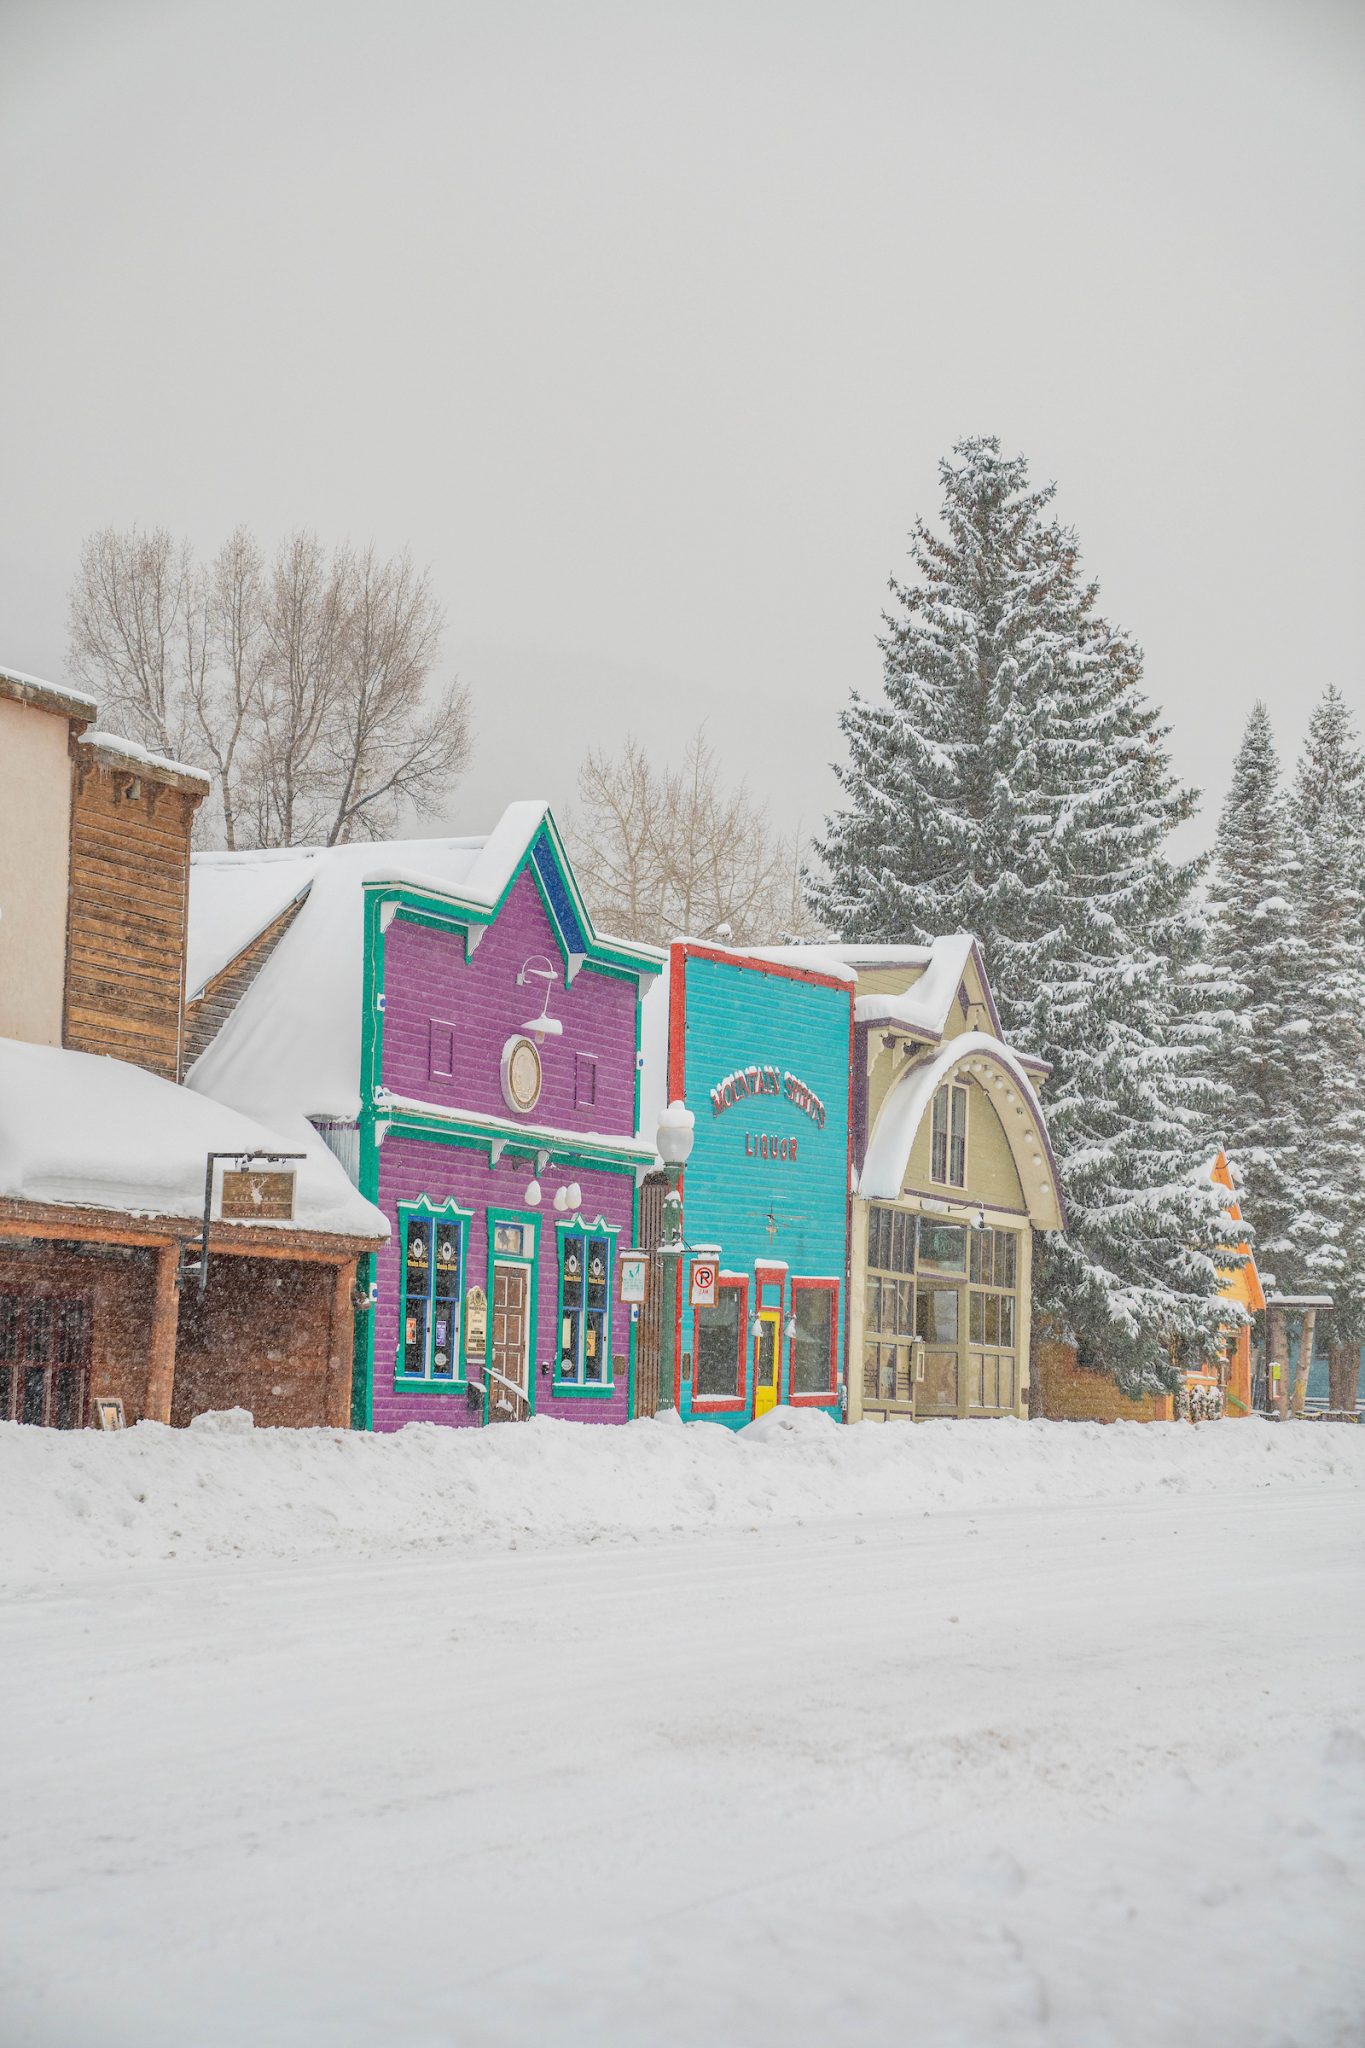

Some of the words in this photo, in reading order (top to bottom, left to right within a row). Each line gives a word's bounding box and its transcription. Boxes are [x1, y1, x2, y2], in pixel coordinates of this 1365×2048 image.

[710, 1066, 781, 1119] MOUNTAIN
[784, 1071, 826, 1130] SPIRITS
[745, 1132, 798, 1161] LIQUOR
